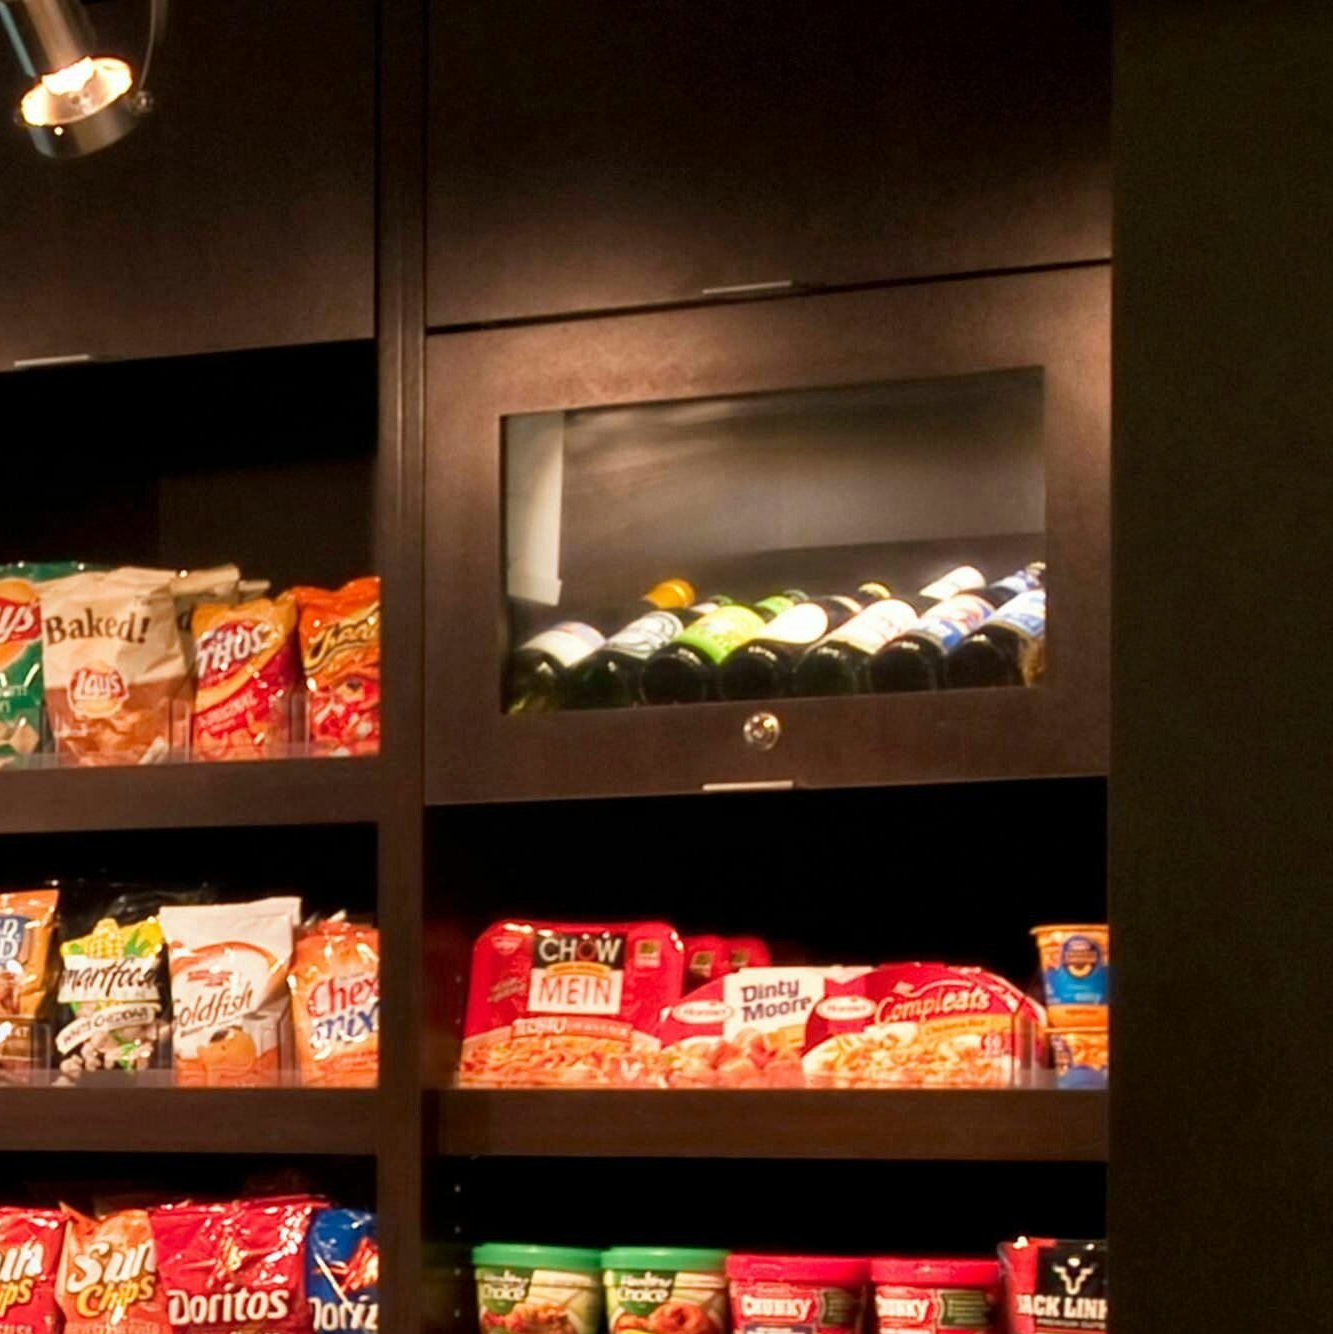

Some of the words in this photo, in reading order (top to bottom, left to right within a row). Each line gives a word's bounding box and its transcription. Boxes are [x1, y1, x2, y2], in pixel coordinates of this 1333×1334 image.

[44, 608, 151, 646] Baked!
[538, 937, 622, 963] CHOW
[308, 977, 380, 1018] Chex
[538, 976, 611, 1005] MEIN
[741, 979, 800, 1003] Dinty
[875, 984, 991, 1025] Compleats
[66, 1239, 156, 1294] Sun
[76, 1274, 155, 1318] Chips
[167, 1284, 290, 1327] Doritos
[619, 1286, 670, 1302] Choice
[740, 1294, 813, 1323] CHUNKY
[875, 1295, 929, 1323] HUNKY
